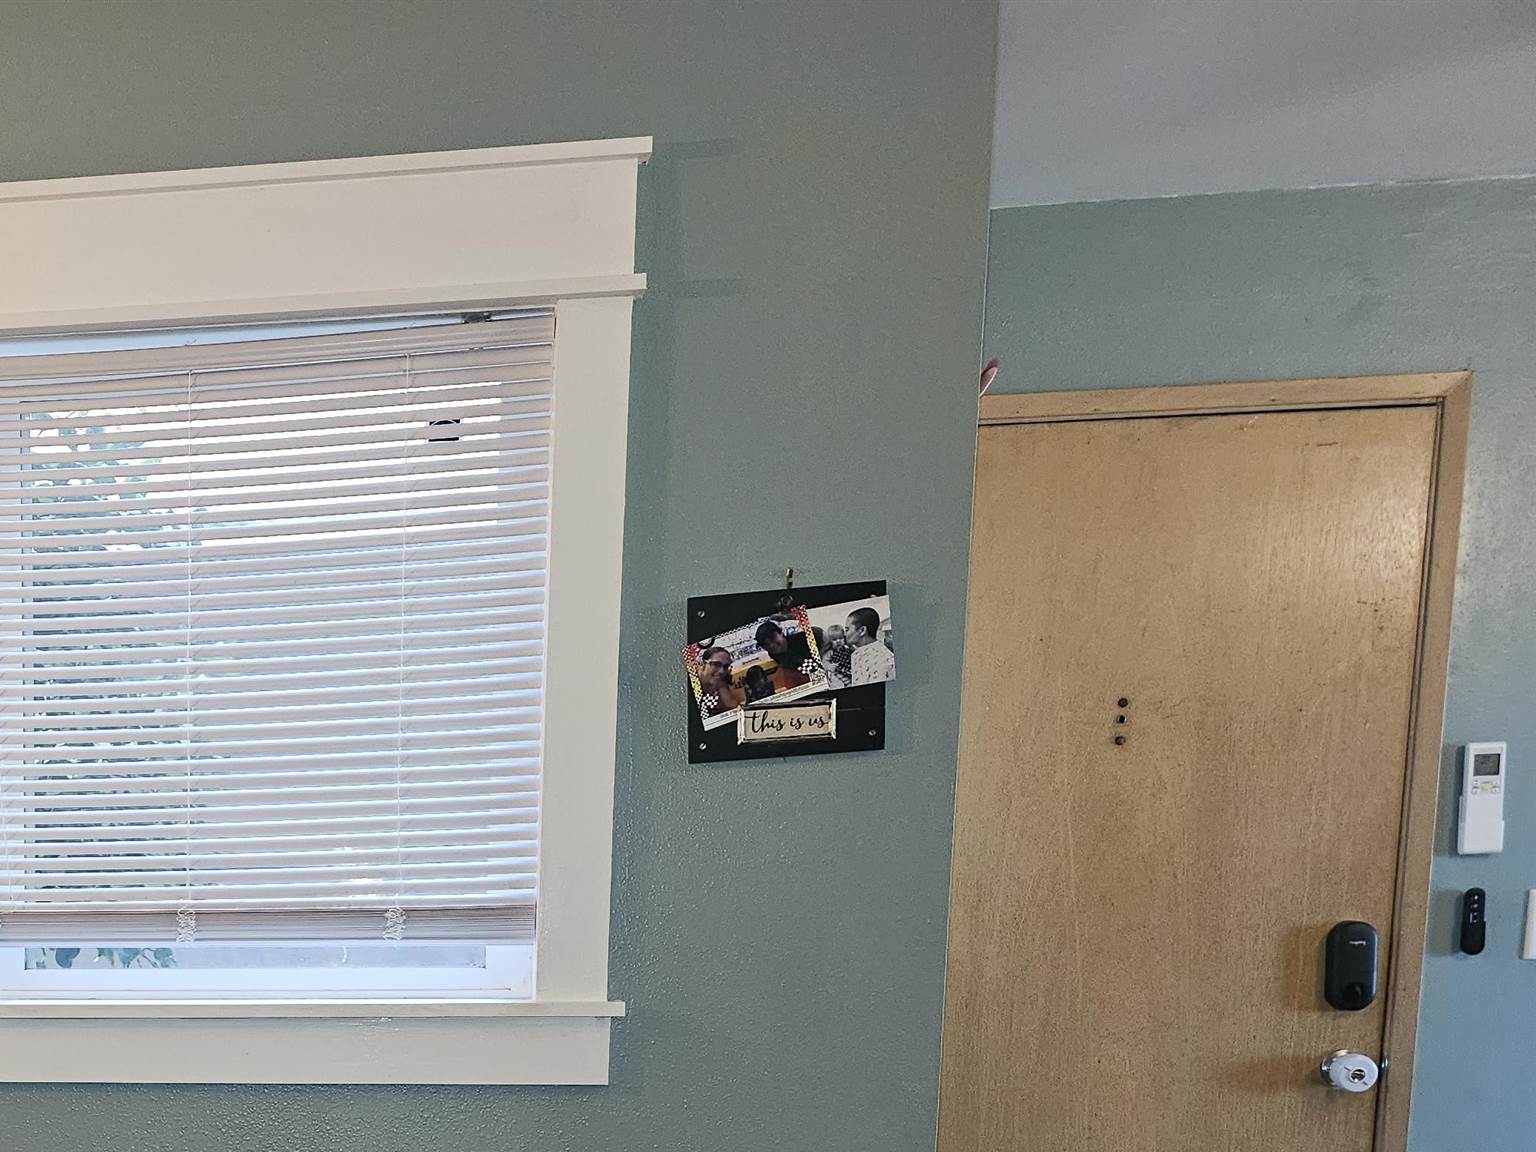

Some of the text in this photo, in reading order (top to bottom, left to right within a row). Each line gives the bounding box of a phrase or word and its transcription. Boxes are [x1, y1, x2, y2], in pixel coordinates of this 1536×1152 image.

[744, 710, 785, 733] this
[790, 717, 804, 730] is
[808, 716, 829, 729] us
